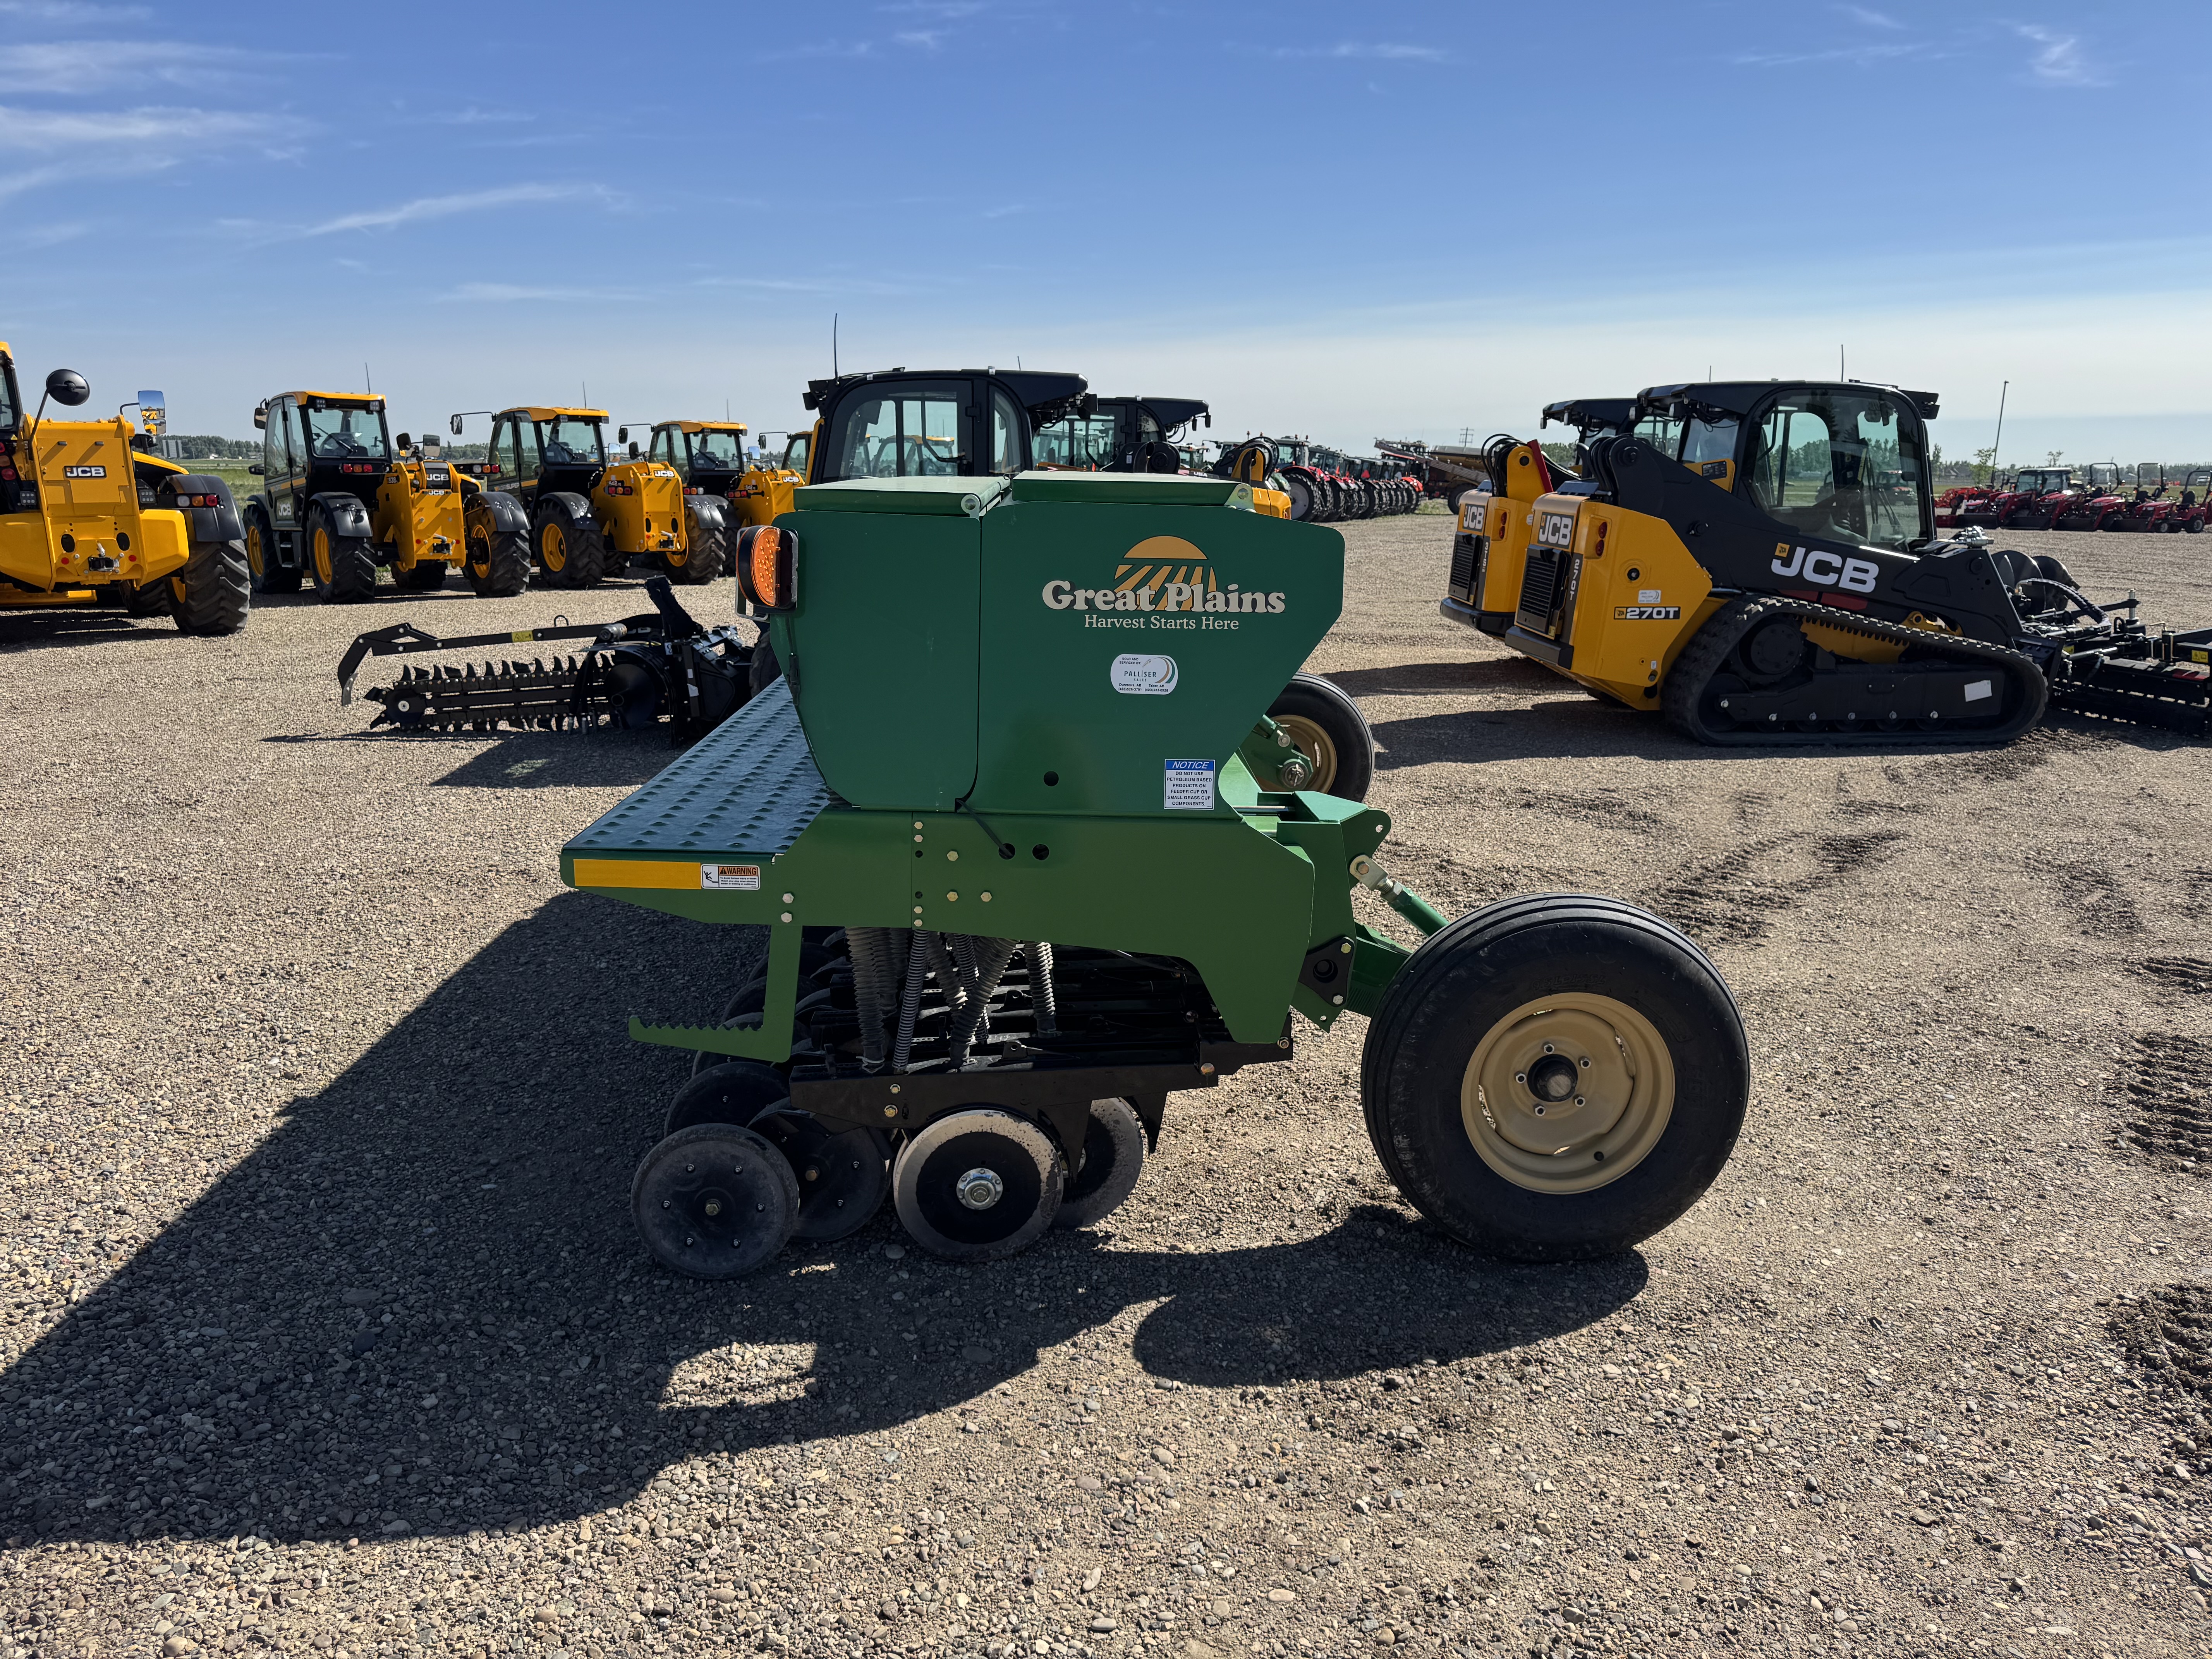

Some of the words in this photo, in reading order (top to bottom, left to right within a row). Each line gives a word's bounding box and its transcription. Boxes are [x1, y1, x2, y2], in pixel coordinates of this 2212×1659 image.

[67, 467, 105, 477] JCB
[279, 503, 292, 516] JCB
[1463, 506, 1484, 530] JCB
[1539, 515, 1572, 546] JCB
[1570, 559, 1580, 600] 270T
[1771, 546, 1879, 593] JCB
[1042, 580, 1157, 611] Great
[1164, 582, 1286, 613] Plains
[1084, 615, 1146, 629] Harvest
[1150, 615, 1196, 630] Starts
[1201, 617, 1239, 630] Here
[1626, 607, 1679, 619] 270T
